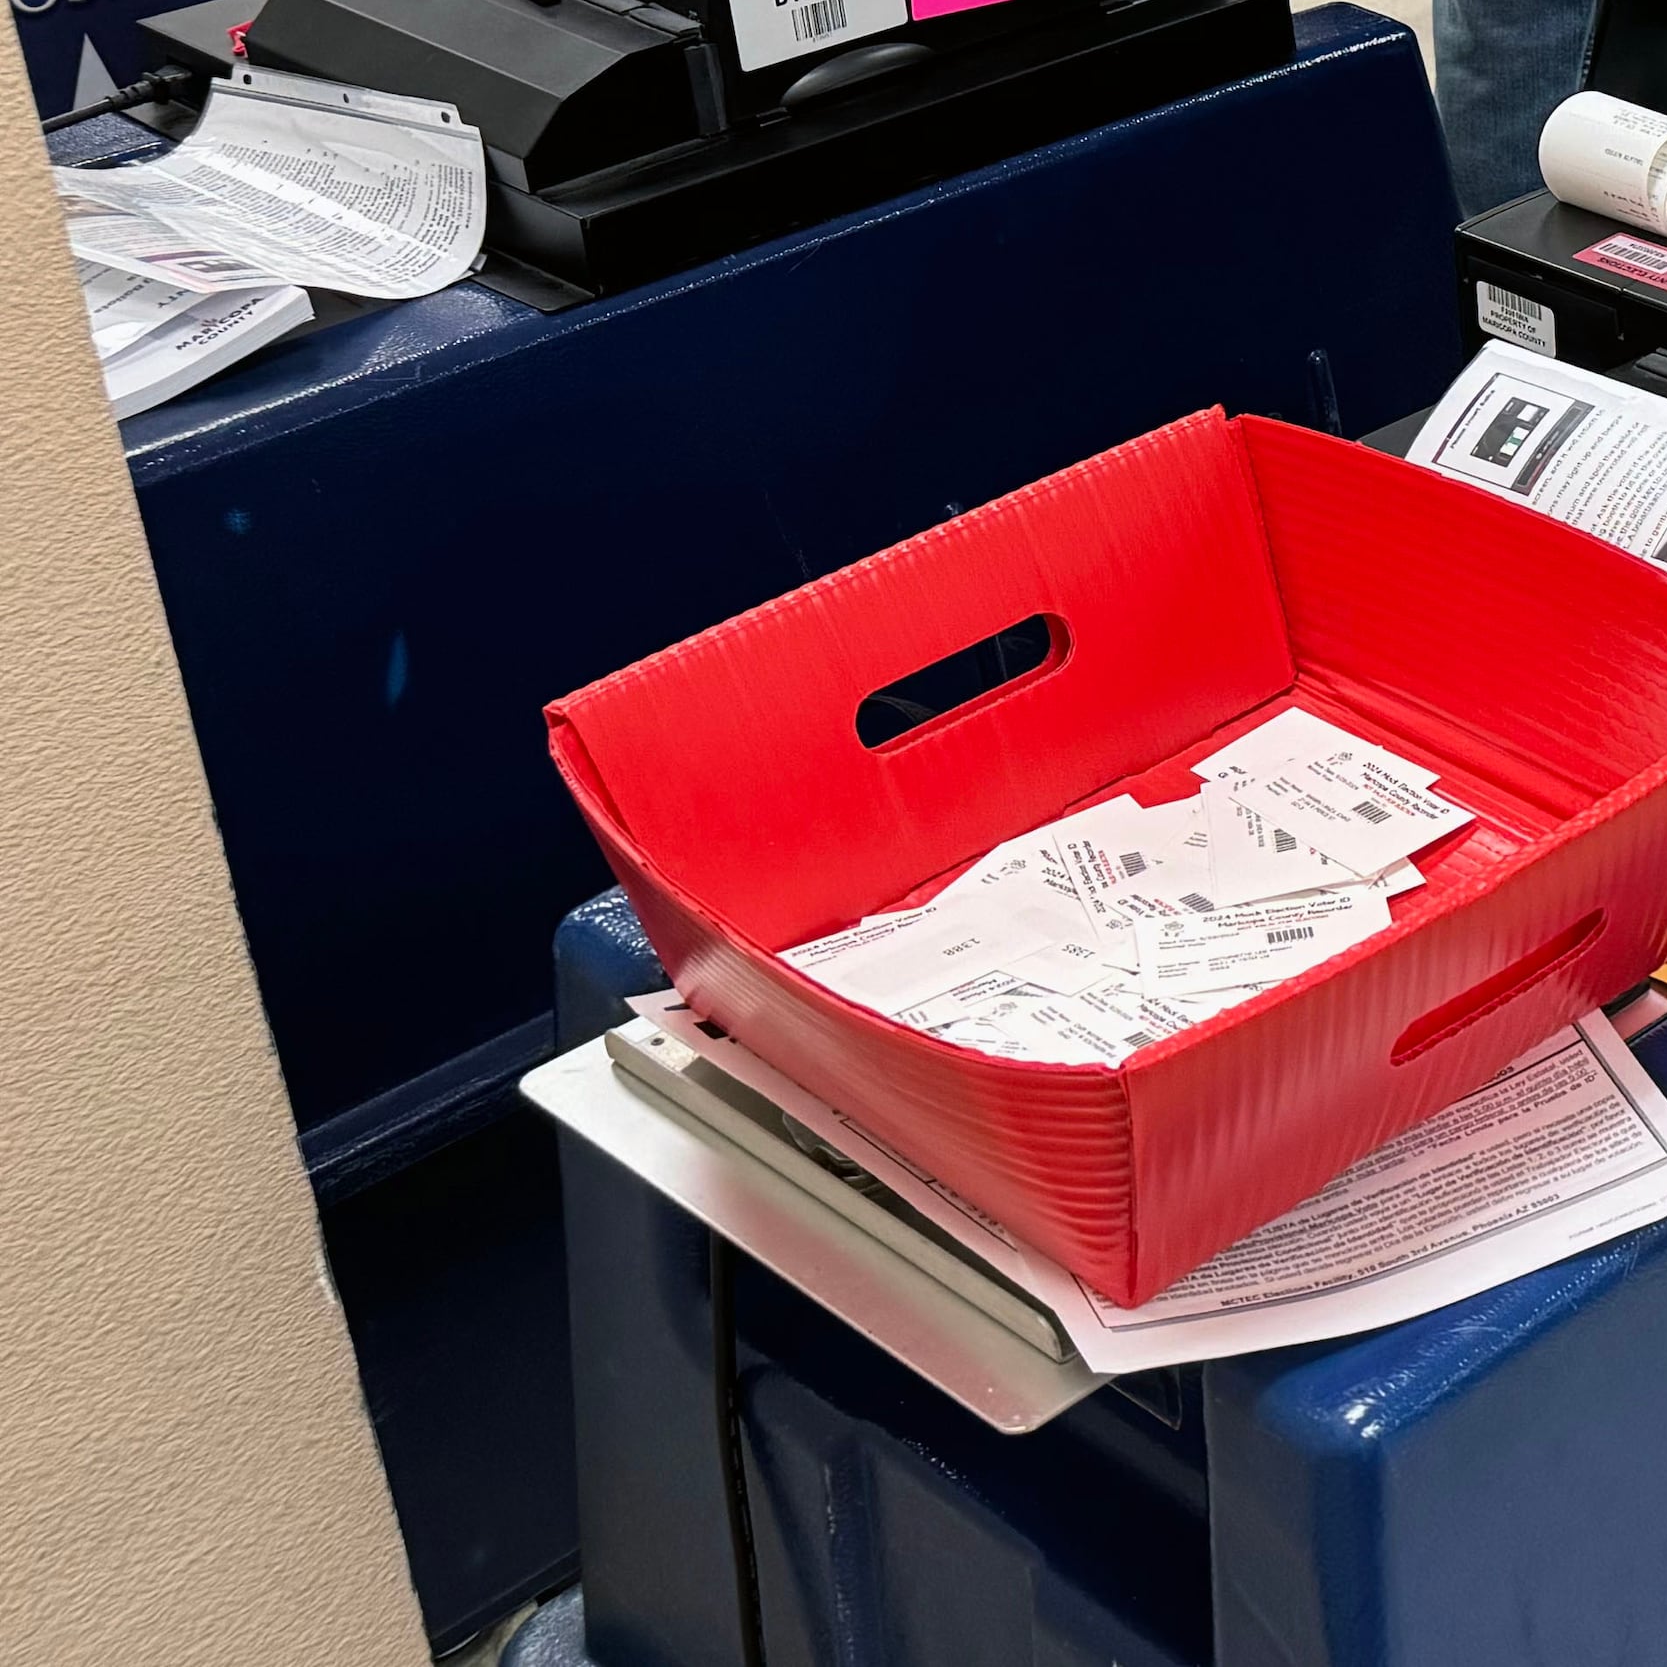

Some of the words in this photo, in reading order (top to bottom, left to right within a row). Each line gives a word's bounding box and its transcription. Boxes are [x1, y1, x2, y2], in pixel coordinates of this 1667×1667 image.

[1555, 481, 1571, 498] may
[1580, 450, 1592, 462] up
[1588, 435, 1604, 450] and
[1577, 481, 1591, 496] and
[1581, 488, 1597, 506] were
[1595, 504, 1609, 518] Ask
[1606, 488, 1618, 501] the
[1601, 502, 1621, 525] booth
[1617, 490, 1627, 500] to
[1622, 493, 1637, 510] new
[1618, 520, 1632, 534] the
[1628, 500, 1645, 518] gold
[1626, 532, 1636, 541] A
[1644, 537, 1654, 547] to
[1379, 772, 1399, 784] Mock
[1387, 790, 1411, 804] County
[1202, 912, 1231, 924] 2024
[1235, 908, 1262, 919] Mock
[1265, 902, 1305, 915] Election
[1308, 897, 1335, 908] Voter
[1339, 895, 1350, 903] ID
[1217, 915, 1265, 930] Maricopa
[1268, 909, 1304, 922] County
[1377, 1250, 1409, 1270] South
[1409, 1242, 1430, 1258] 3rd
[1471, 1211, 1515, 1234] Phoenix
[1514, 1201, 1533, 1218] AZ
